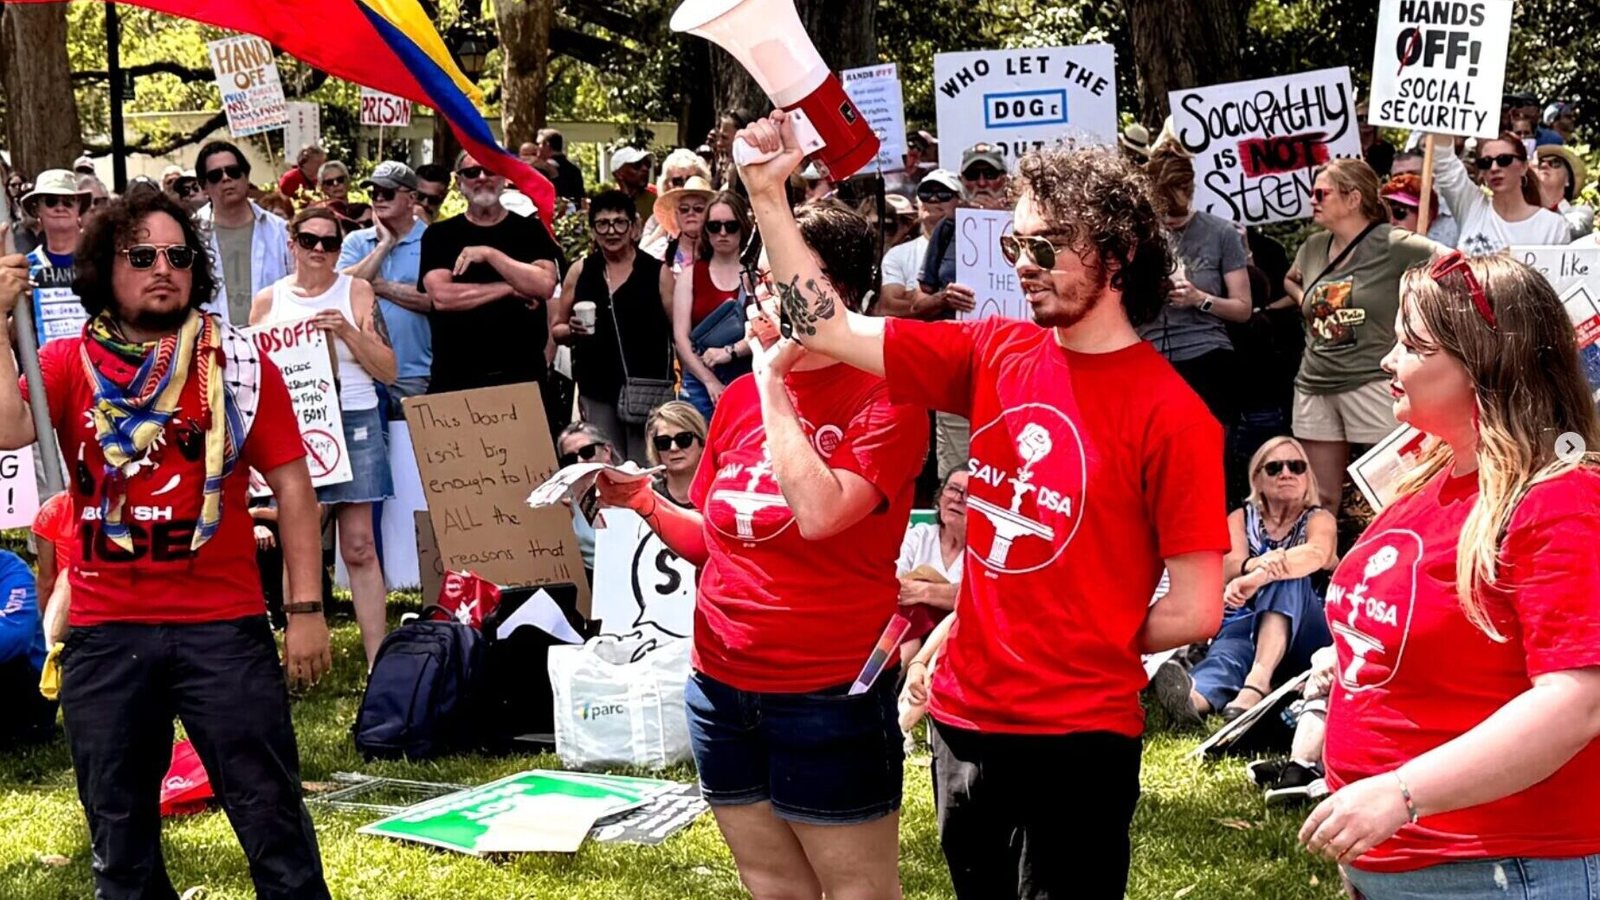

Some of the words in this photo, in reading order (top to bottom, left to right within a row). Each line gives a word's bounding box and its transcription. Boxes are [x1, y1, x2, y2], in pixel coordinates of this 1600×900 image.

[1399, 0, 1485, 27] HANDS
[1396, 25, 1482, 76] OFF!
[940, 59, 990, 98] WHO
[1007, 56, 1050, 75] LET
[1064, 61, 1108, 96] THE
[1399, 77, 1475, 105] SOCIAL
[362, 97, 410, 124] PRISON
[1380, 99, 1488, 132] SECURITY
[1213, 148, 1237, 170] IS
[1247, 137, 1318, 173] NOT
[1561, 252, 1589, 276] like
[988, 272, 1014, 292] THE
[412, 403, 461, 429] This
[464, 398, 518, 426] board
[480, 438, 508, 466] big
[429, 471, 496, 495] enough
[501, 470, 520, 484] to
[967, 458, 1007, 488] SAV
[1036, 486, 1073, 518] DSA
[444, 505, 482, 535] ALL
[492, 504, 521, 526] the
[449, 549, 514, 566] reasons
[528, 539, 565, 558] that
[1365, 597, 1398, 628] DSA
[591, 702, 624, 720] parc
